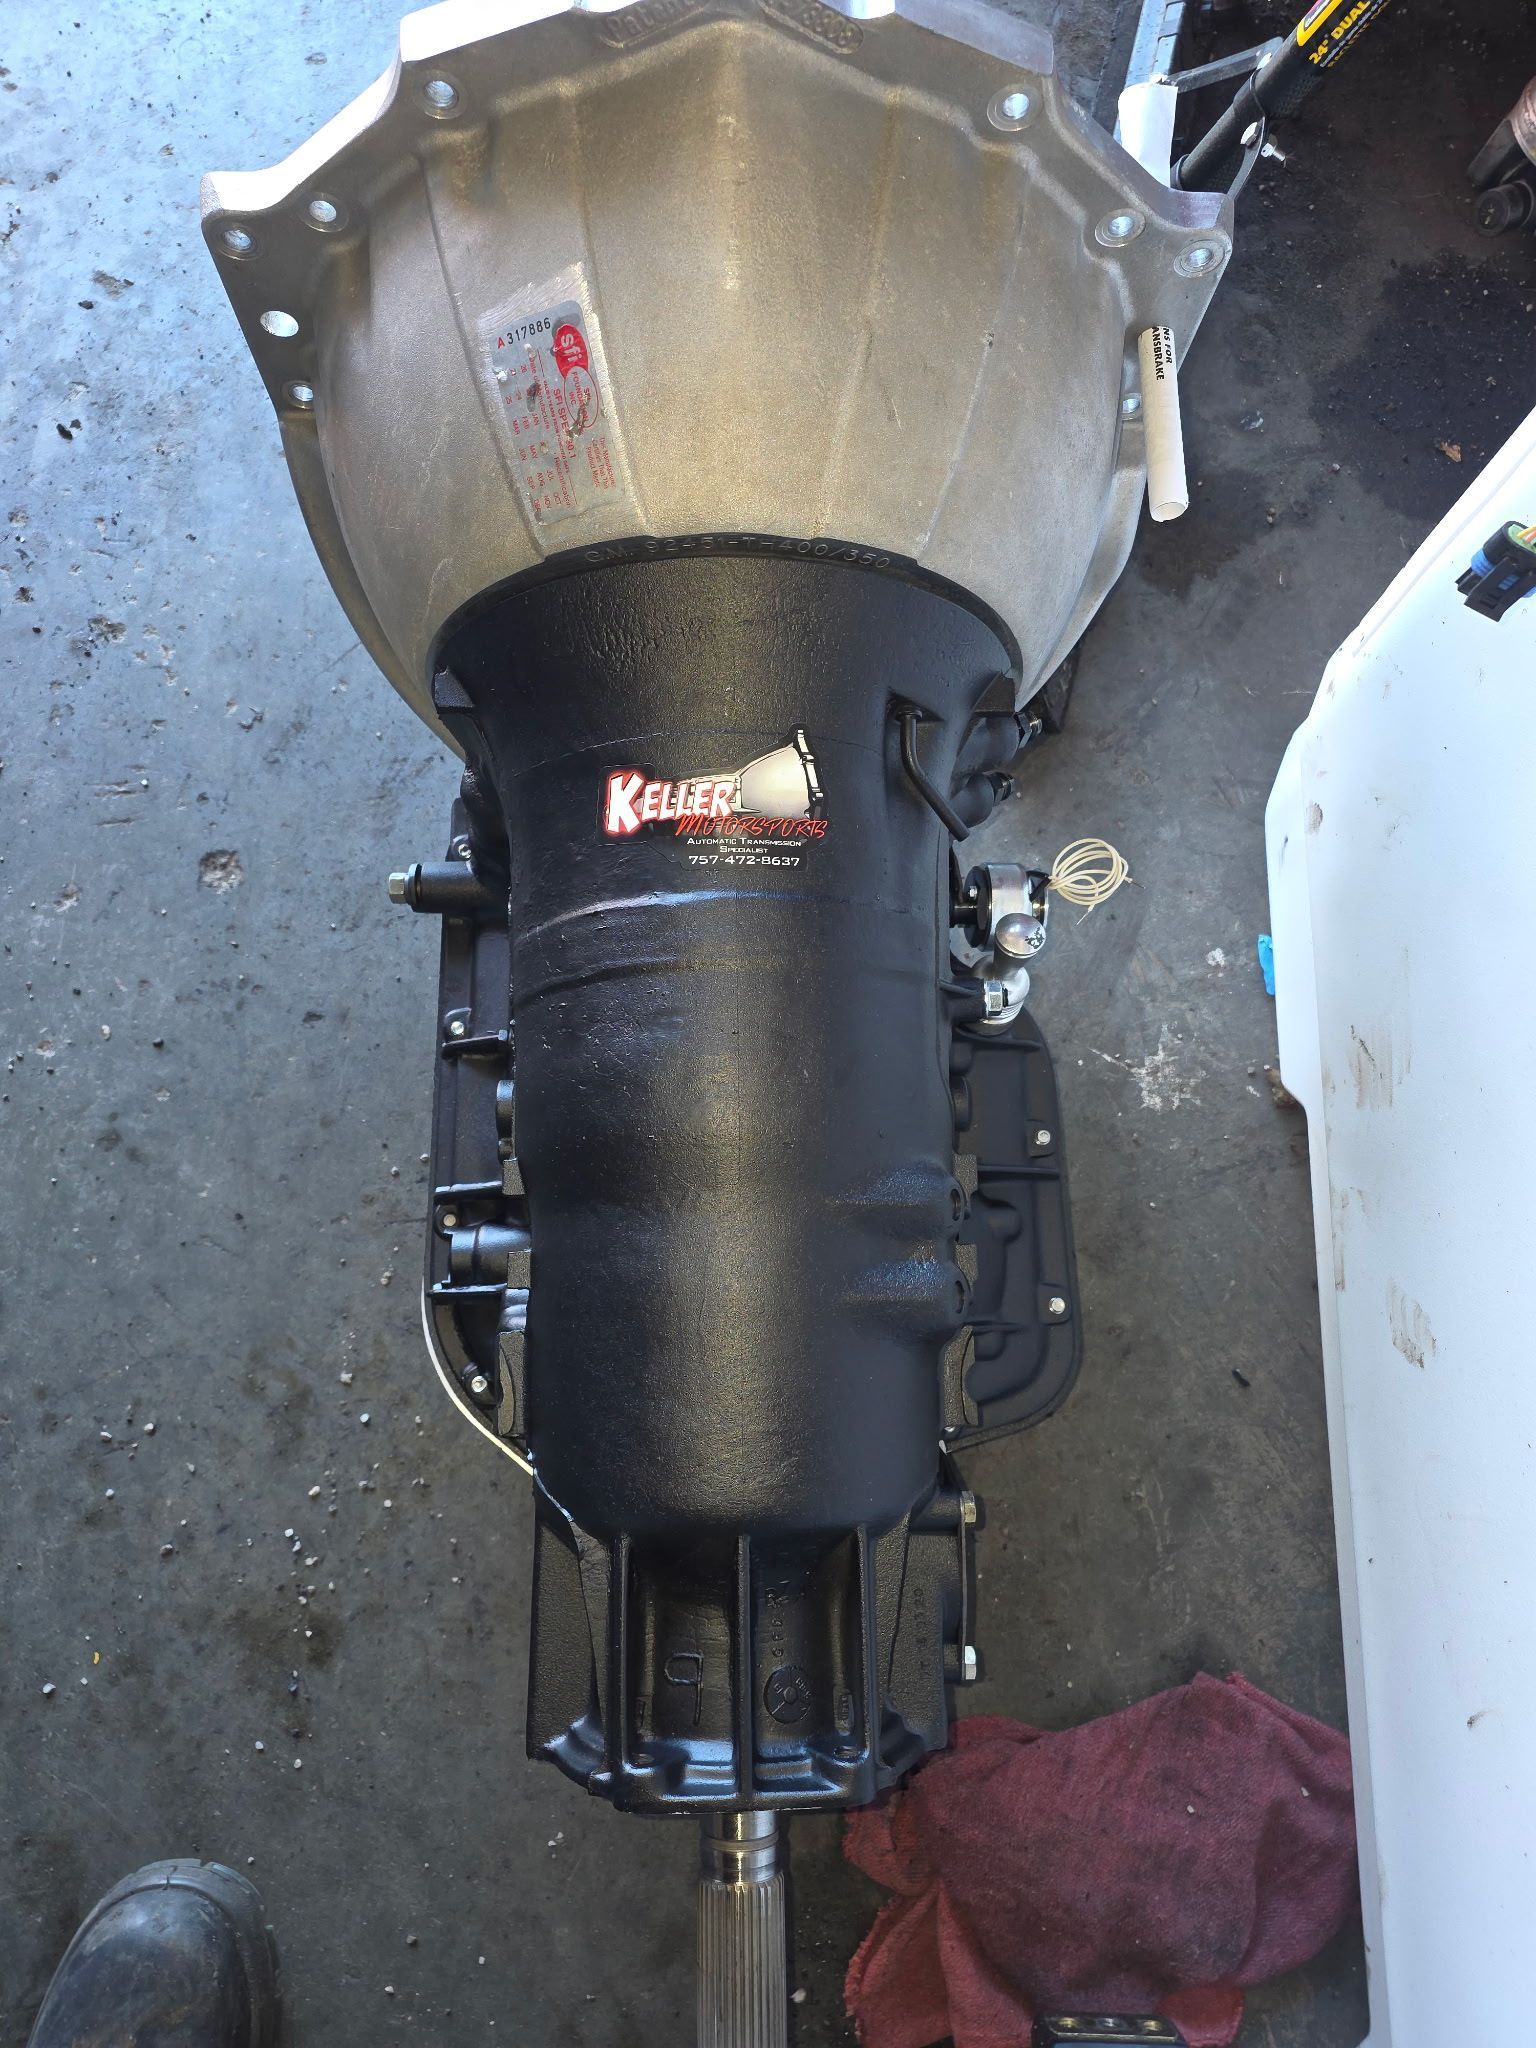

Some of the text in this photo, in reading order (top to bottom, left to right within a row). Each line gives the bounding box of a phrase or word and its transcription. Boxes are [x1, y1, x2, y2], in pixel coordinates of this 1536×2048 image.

[1331, 0, 1371, 40] DUAL
[558, 331, 584, 363] sfi
[552, 388, 563, 406] SFI
[607, 772, 735, 833] KELLER
[675, 814, 829, 839] MOTORSPORTS
[688, 855, 801, 867] 757-472-8637
